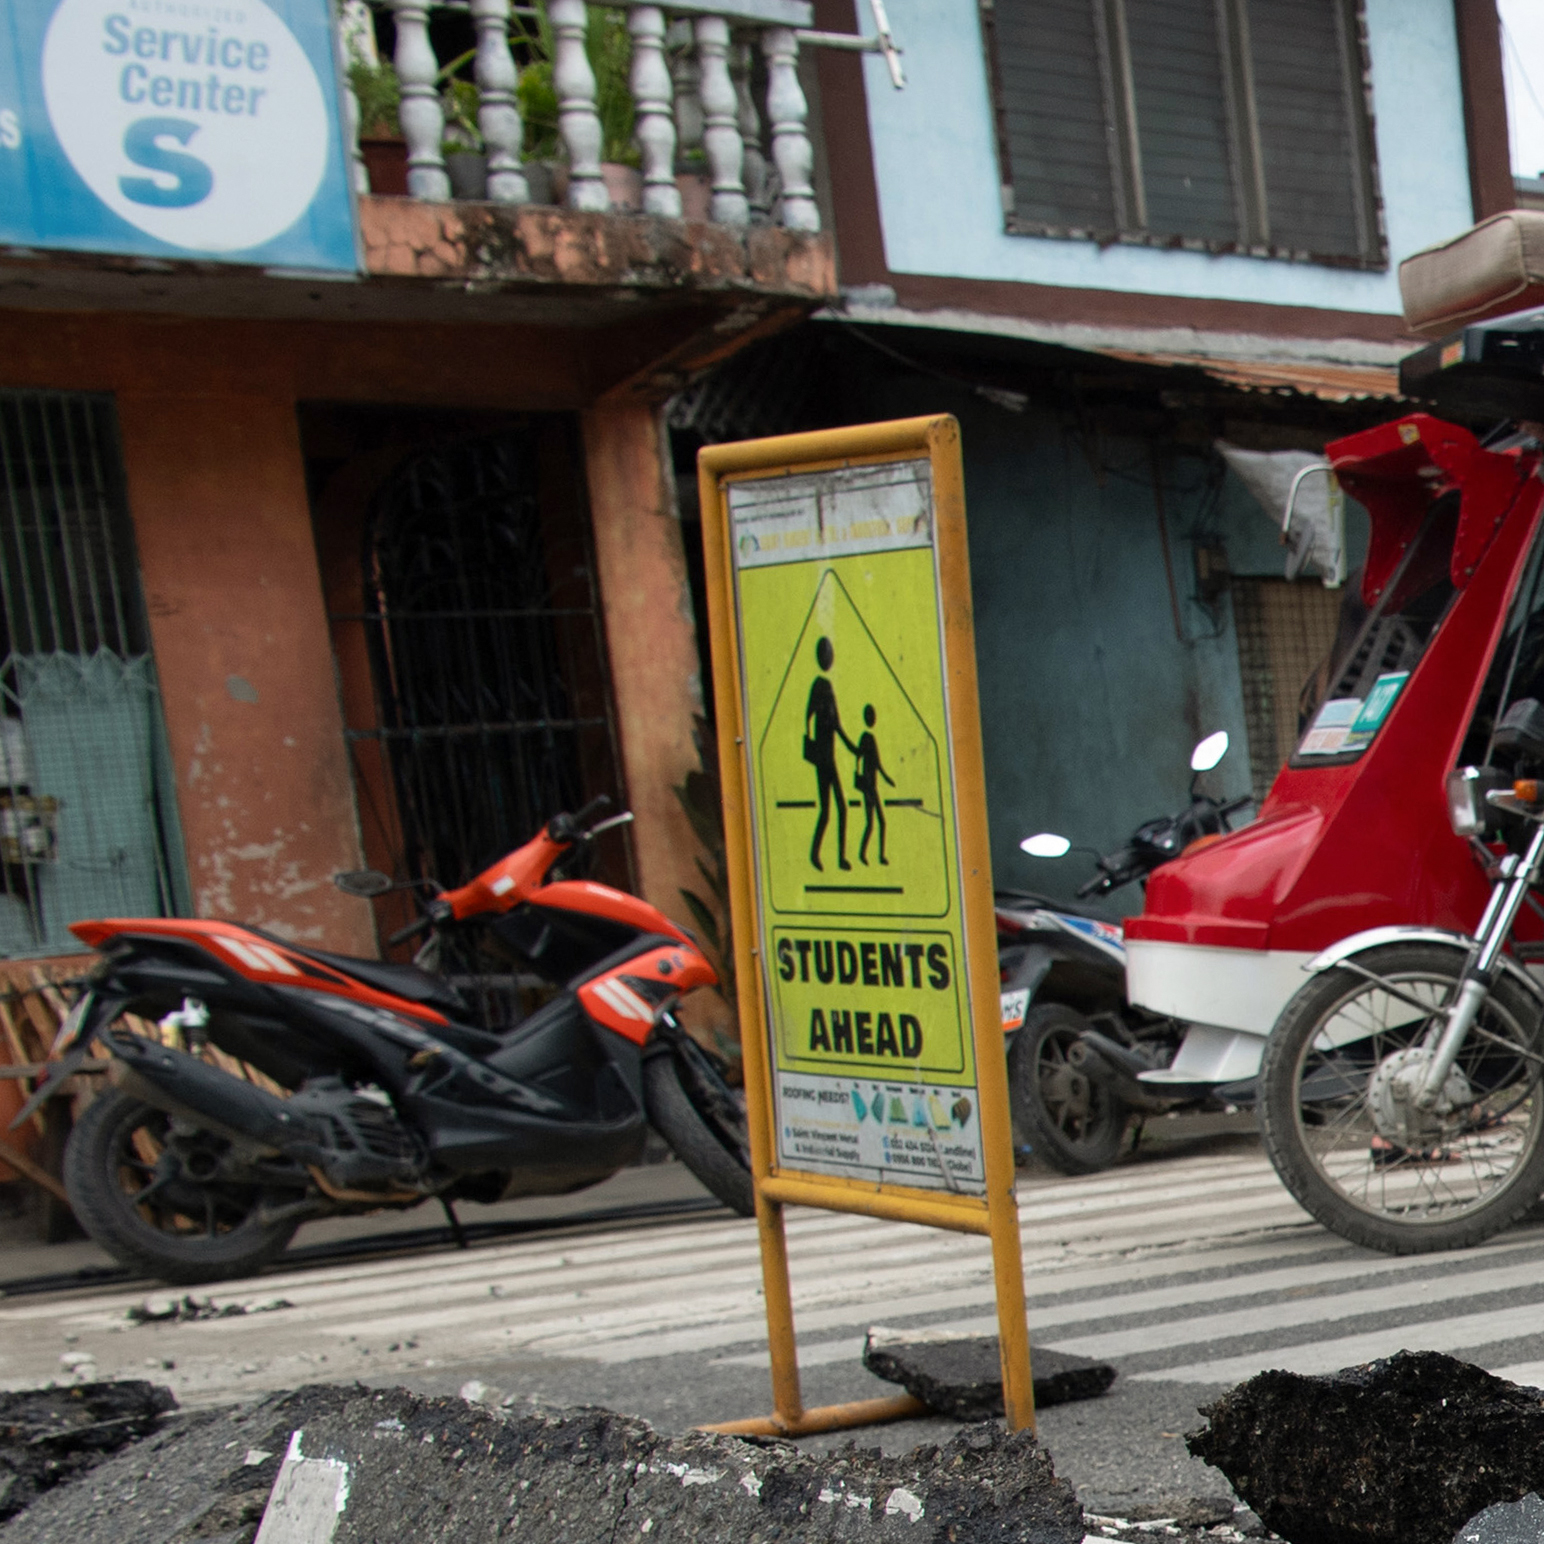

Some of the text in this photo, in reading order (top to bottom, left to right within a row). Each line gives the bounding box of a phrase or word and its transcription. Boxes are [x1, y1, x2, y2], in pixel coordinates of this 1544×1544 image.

[103, 13, 270, 72] Service
[119, 63, 268, 117] Center
[117, 116, 214, 209] S
[777, 937, 951, 991] STUDENTS
[808, 1007, 924, 1059] AHEAD
